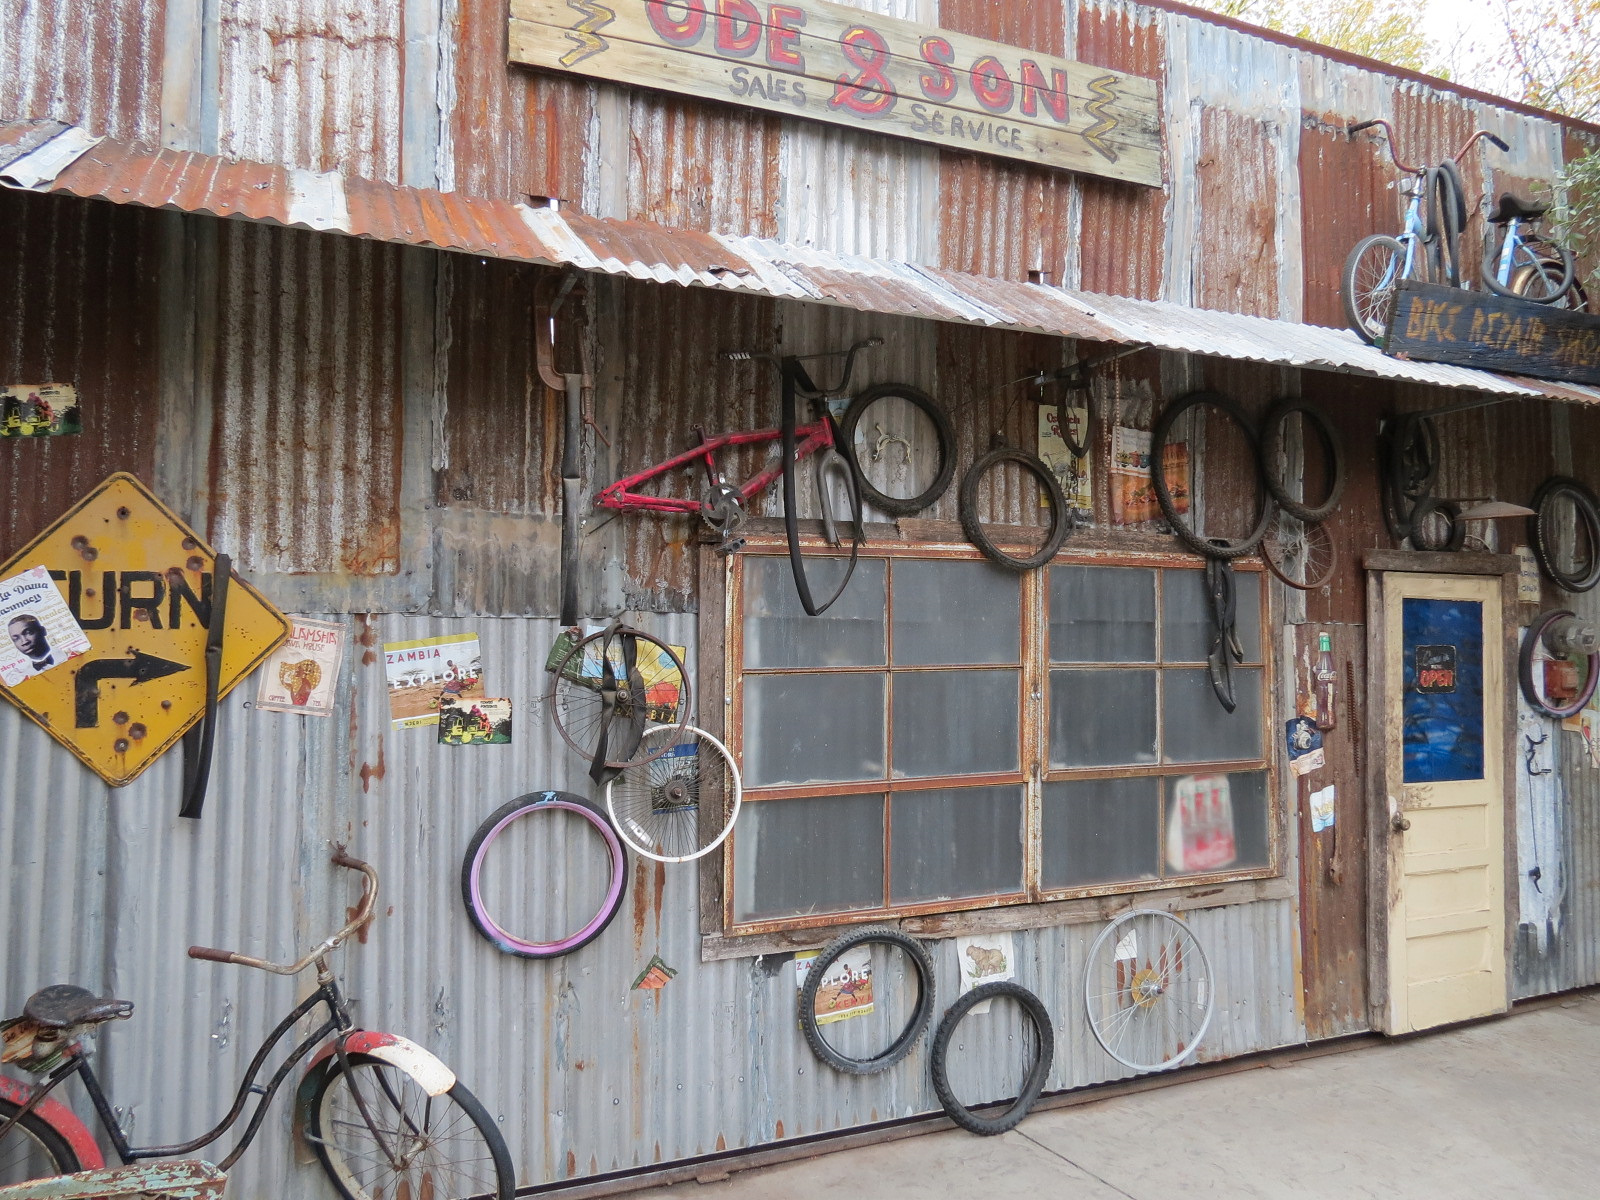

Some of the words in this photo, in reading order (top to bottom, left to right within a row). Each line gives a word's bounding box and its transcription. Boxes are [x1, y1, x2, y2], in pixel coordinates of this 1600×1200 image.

[829, 25, 897, 119] &
[919, 36, 1070, 123] SON
[729, 67, 806, 106] SALES
[910, 104, 1024, 151] SERVICE
[1405, 296, 1463, 342] BIKE
[0, 593, 42, 616] armacy
[289, 626, 337, 645] LAMSHA
[303, 642, 325, 653] HOUSE
[386, 648, 441, 665] ZAMBIA
[393, 666, 479, 690] EXPLORE
[1420, 669, 1453, 687] OPEN
[821, 968, 869, 988] PLORE
[835, 994, 873, 1009] KENYA
